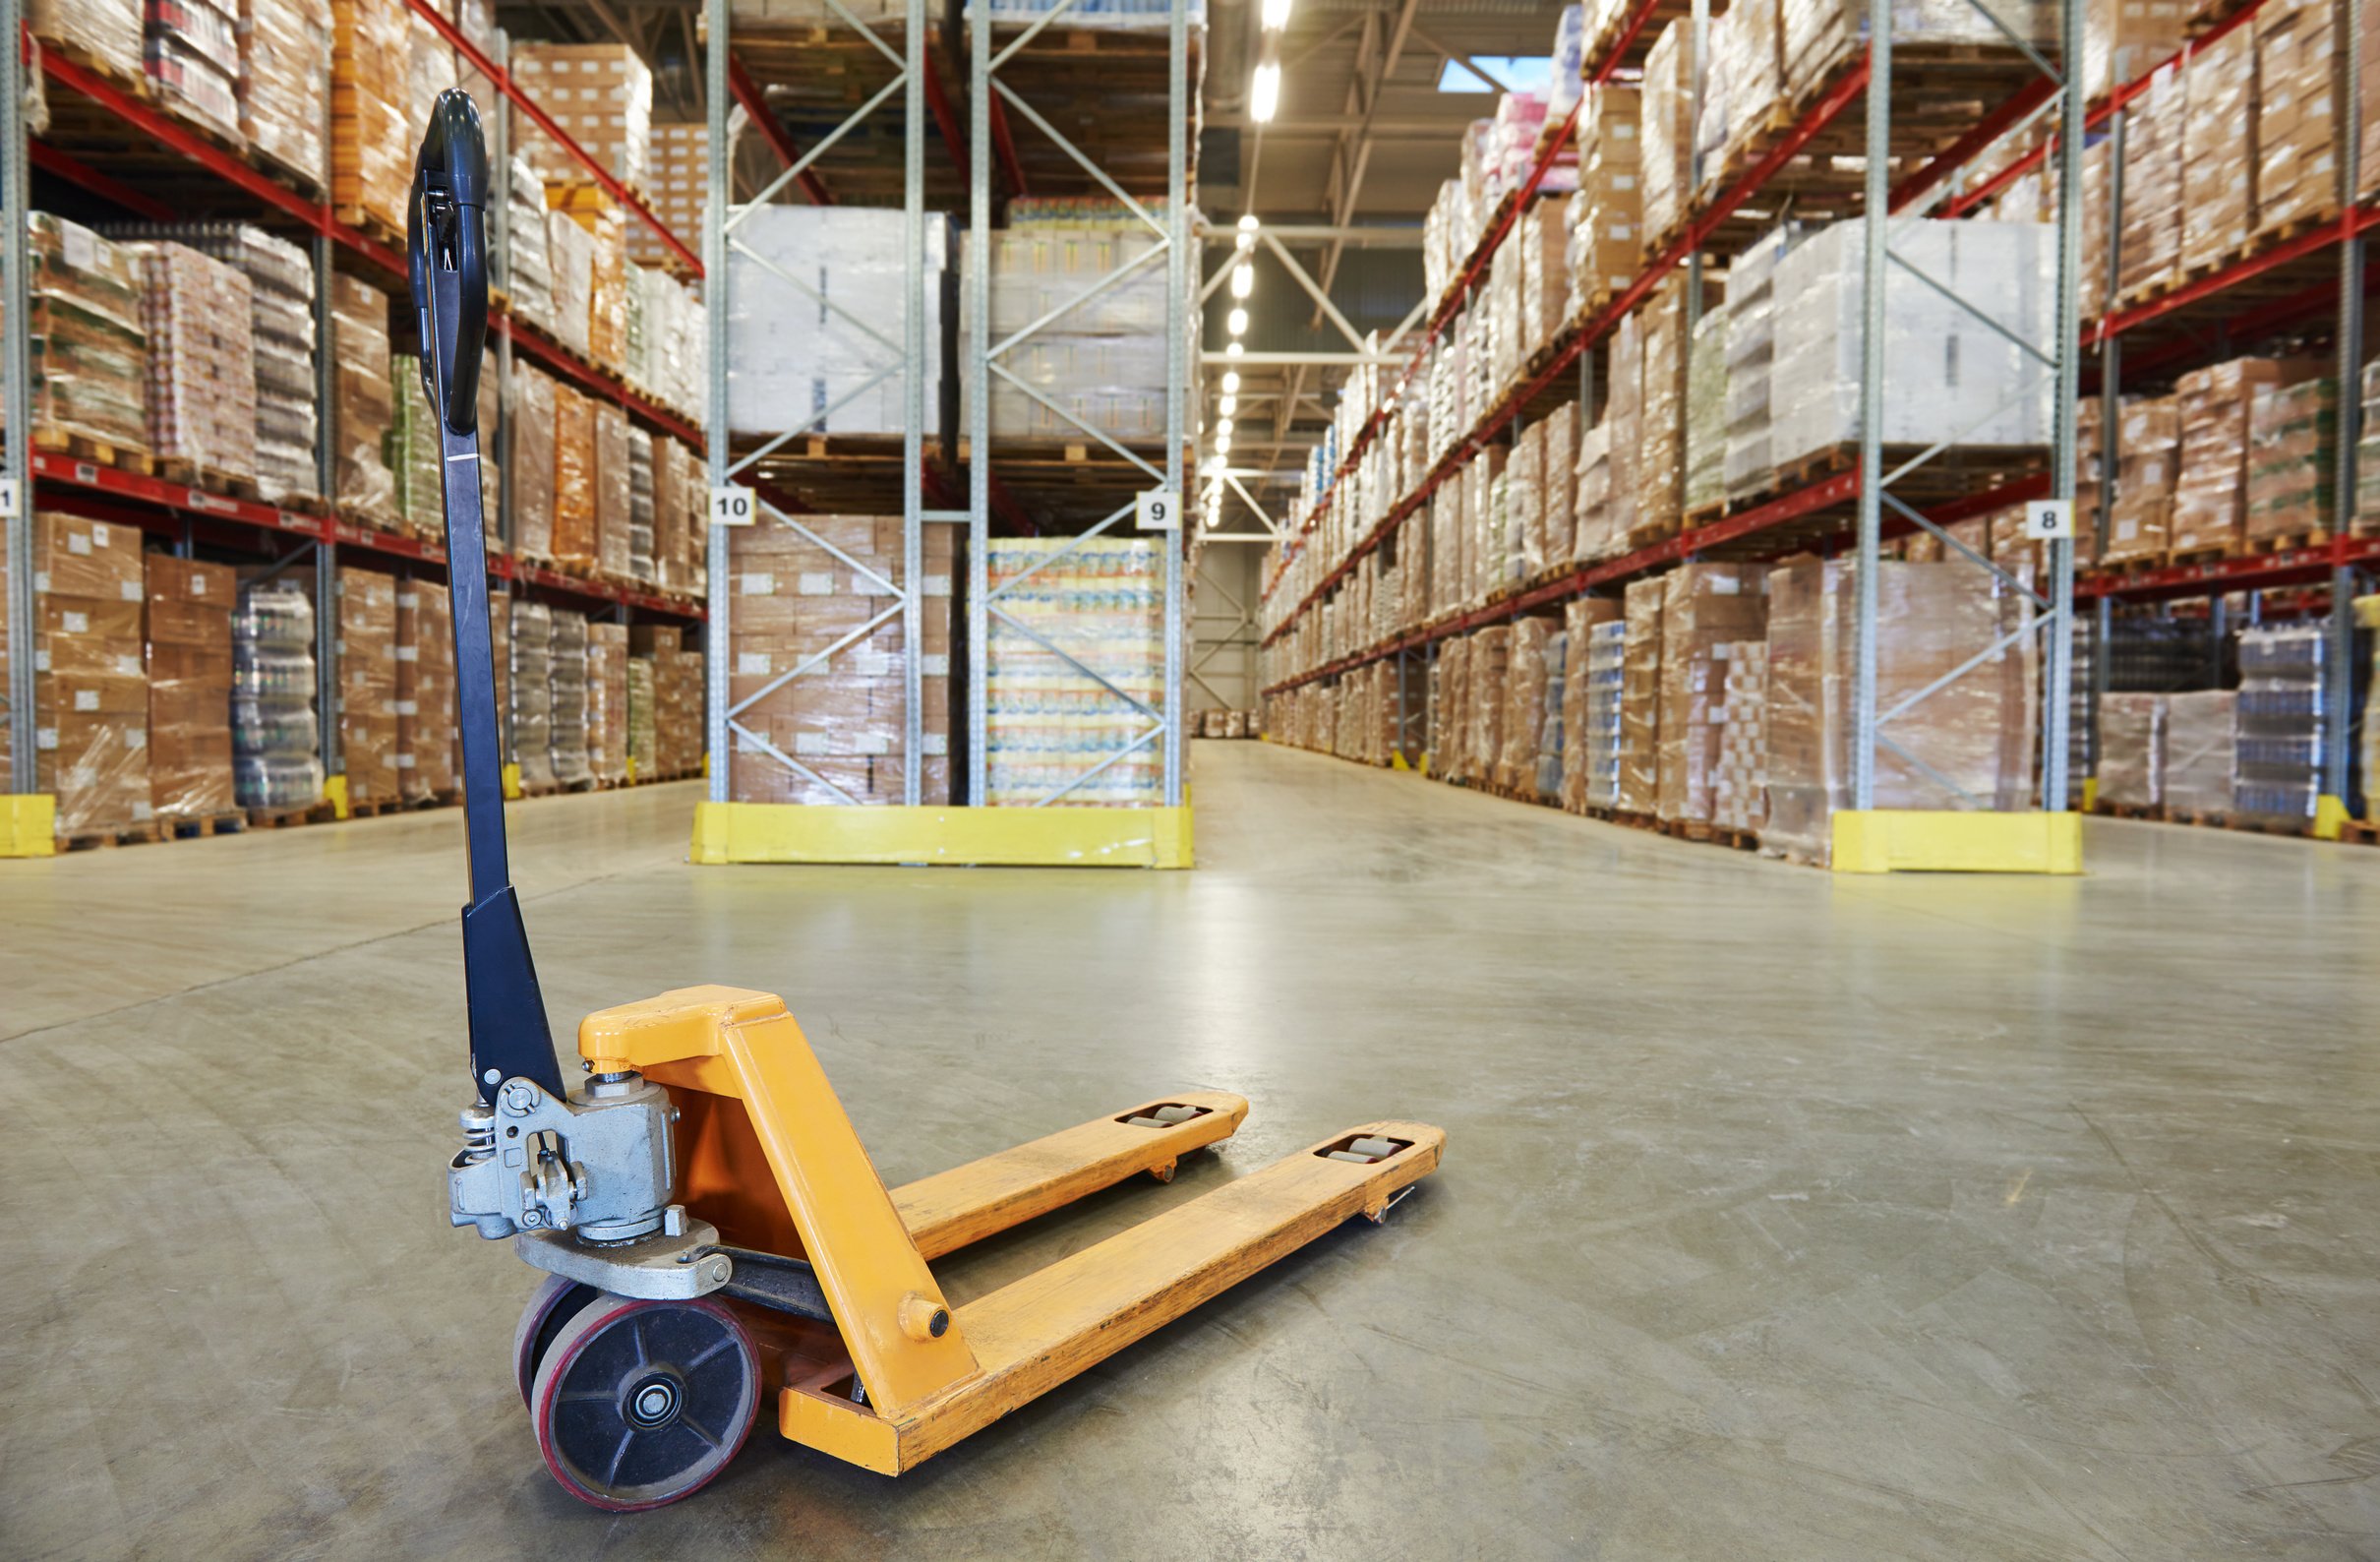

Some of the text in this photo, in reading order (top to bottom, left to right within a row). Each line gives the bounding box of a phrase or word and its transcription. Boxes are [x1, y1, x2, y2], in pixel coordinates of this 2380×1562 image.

[718, 498, 747, 516] 10
[1151, 503, 1166, 521] 9
[2042, 511, 2057, 529] 8
